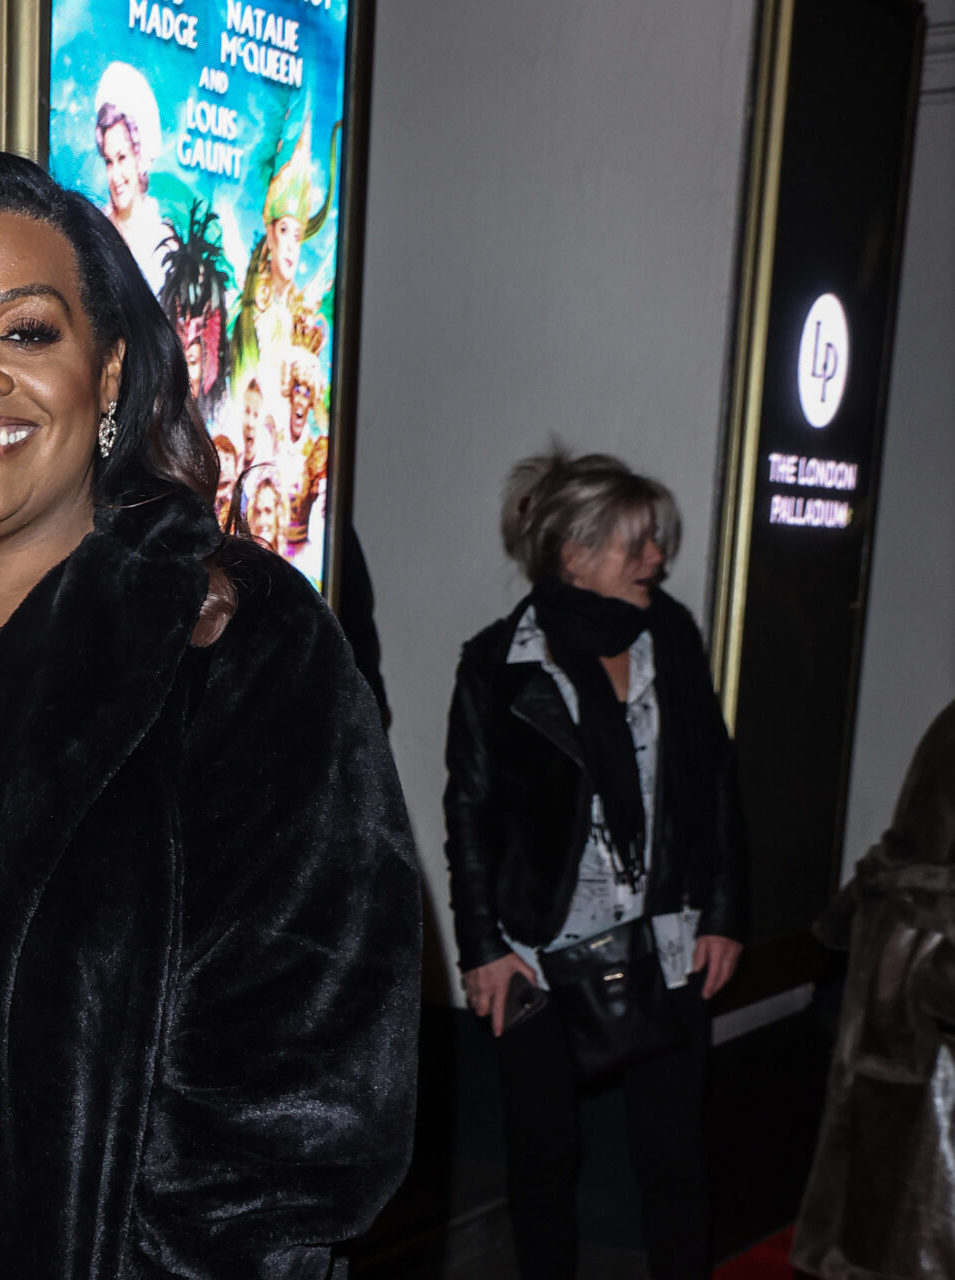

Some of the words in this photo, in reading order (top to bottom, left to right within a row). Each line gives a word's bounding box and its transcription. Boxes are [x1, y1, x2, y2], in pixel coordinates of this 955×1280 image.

[128, 0, 198, 49] MADGE
[227, 0, 300, 52] NATALIE
[198, 66, 229, 94] AND
[187, 97, 238, 140] LOUIS
[177, 133, 244, 178] GAUNT
[768, 452, 797, 485] THE
[797, 456, 858, 490] LONDON
[769, 494, 849, 528] PALLADIUM
